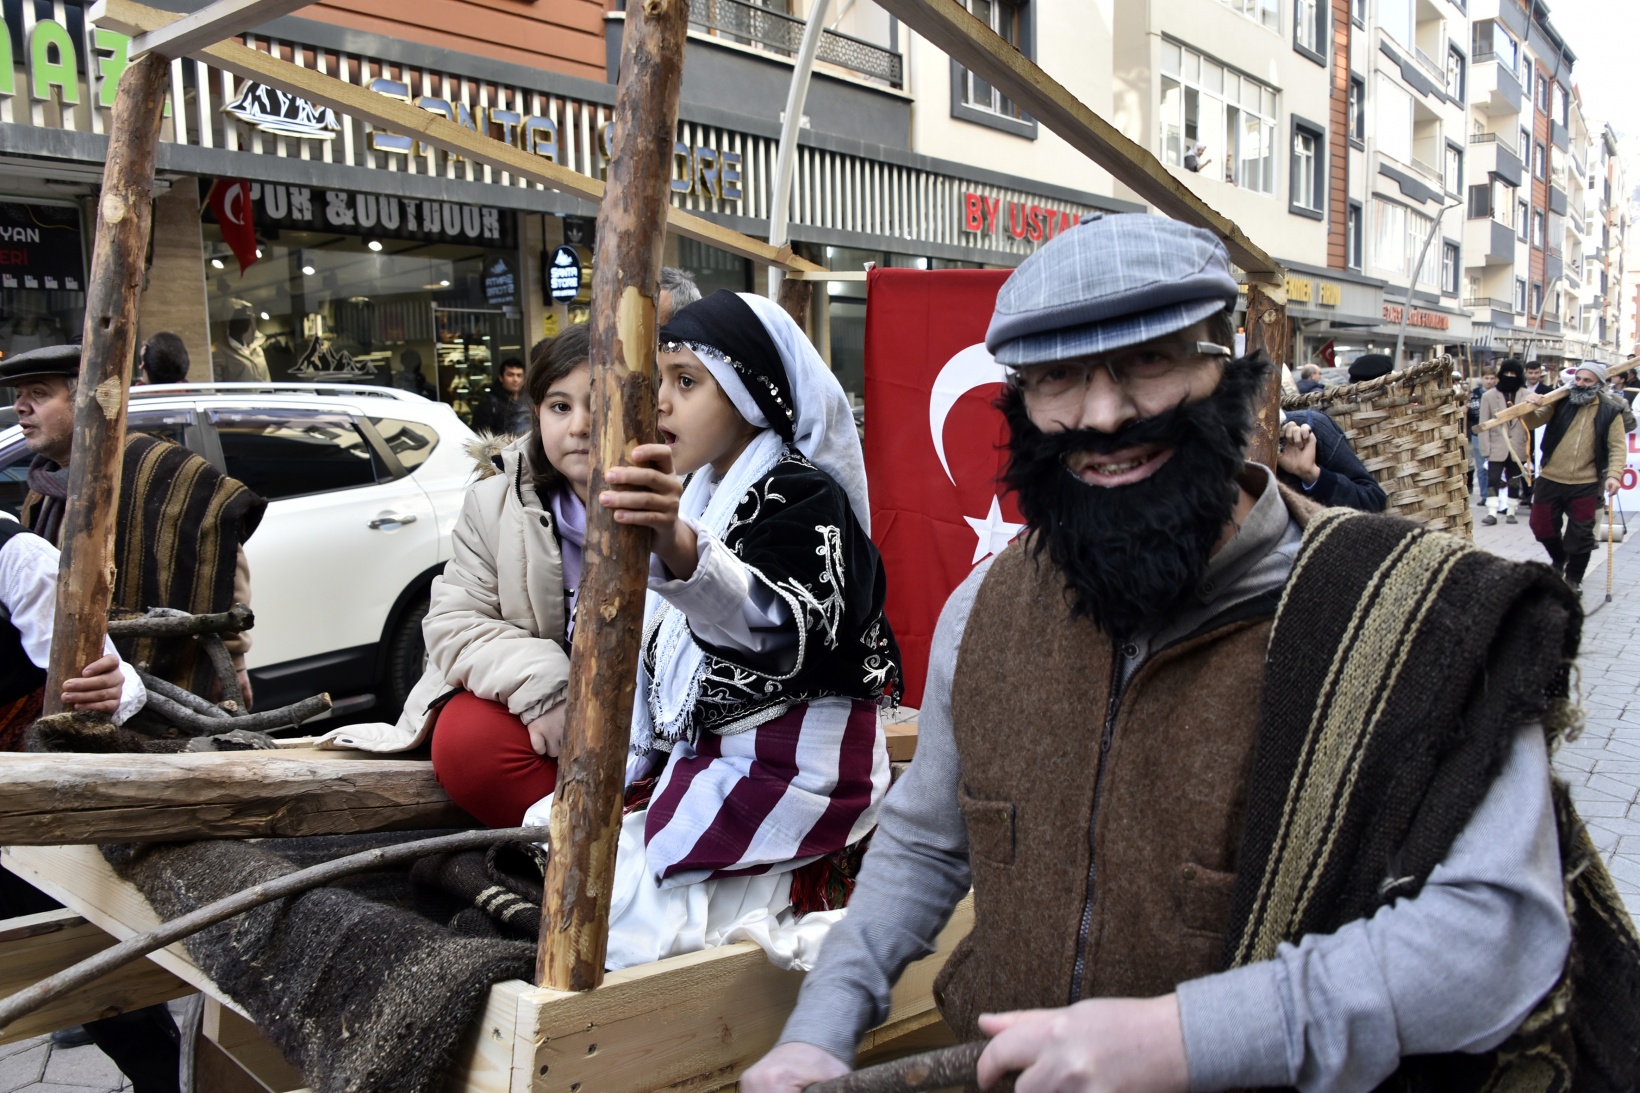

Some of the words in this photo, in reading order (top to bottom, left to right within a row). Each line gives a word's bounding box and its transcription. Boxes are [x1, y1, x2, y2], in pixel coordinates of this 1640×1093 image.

[965, 192, 1001, 235] BY
[0, 226, 40, 243] YAN
[550, 266, 578, 279] SANTA
[550, 277, 578, 289] STORE
